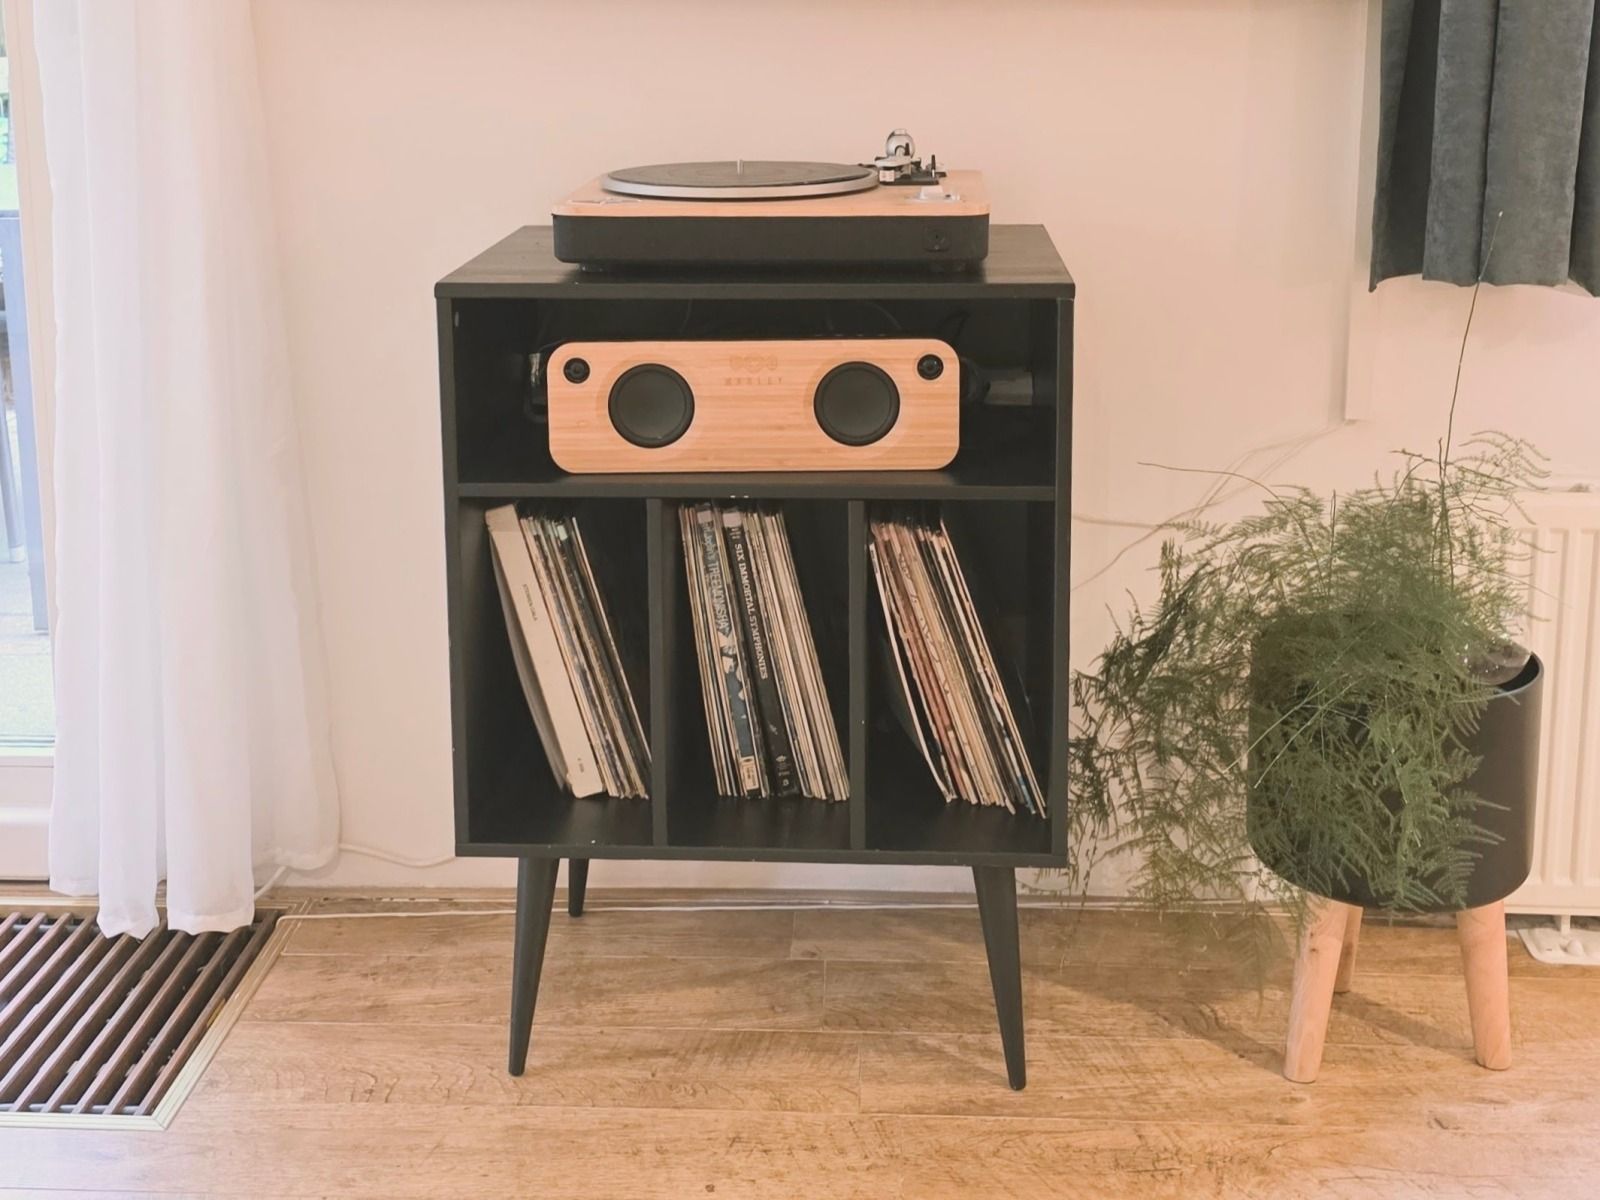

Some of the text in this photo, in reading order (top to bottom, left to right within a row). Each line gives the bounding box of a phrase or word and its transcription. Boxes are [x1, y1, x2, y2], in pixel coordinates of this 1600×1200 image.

[735, 543, 745, 561] SIX
[738, 562, 756, 615] IMMORTAL
[750, 615, 768, 680] SYMPHONIES
